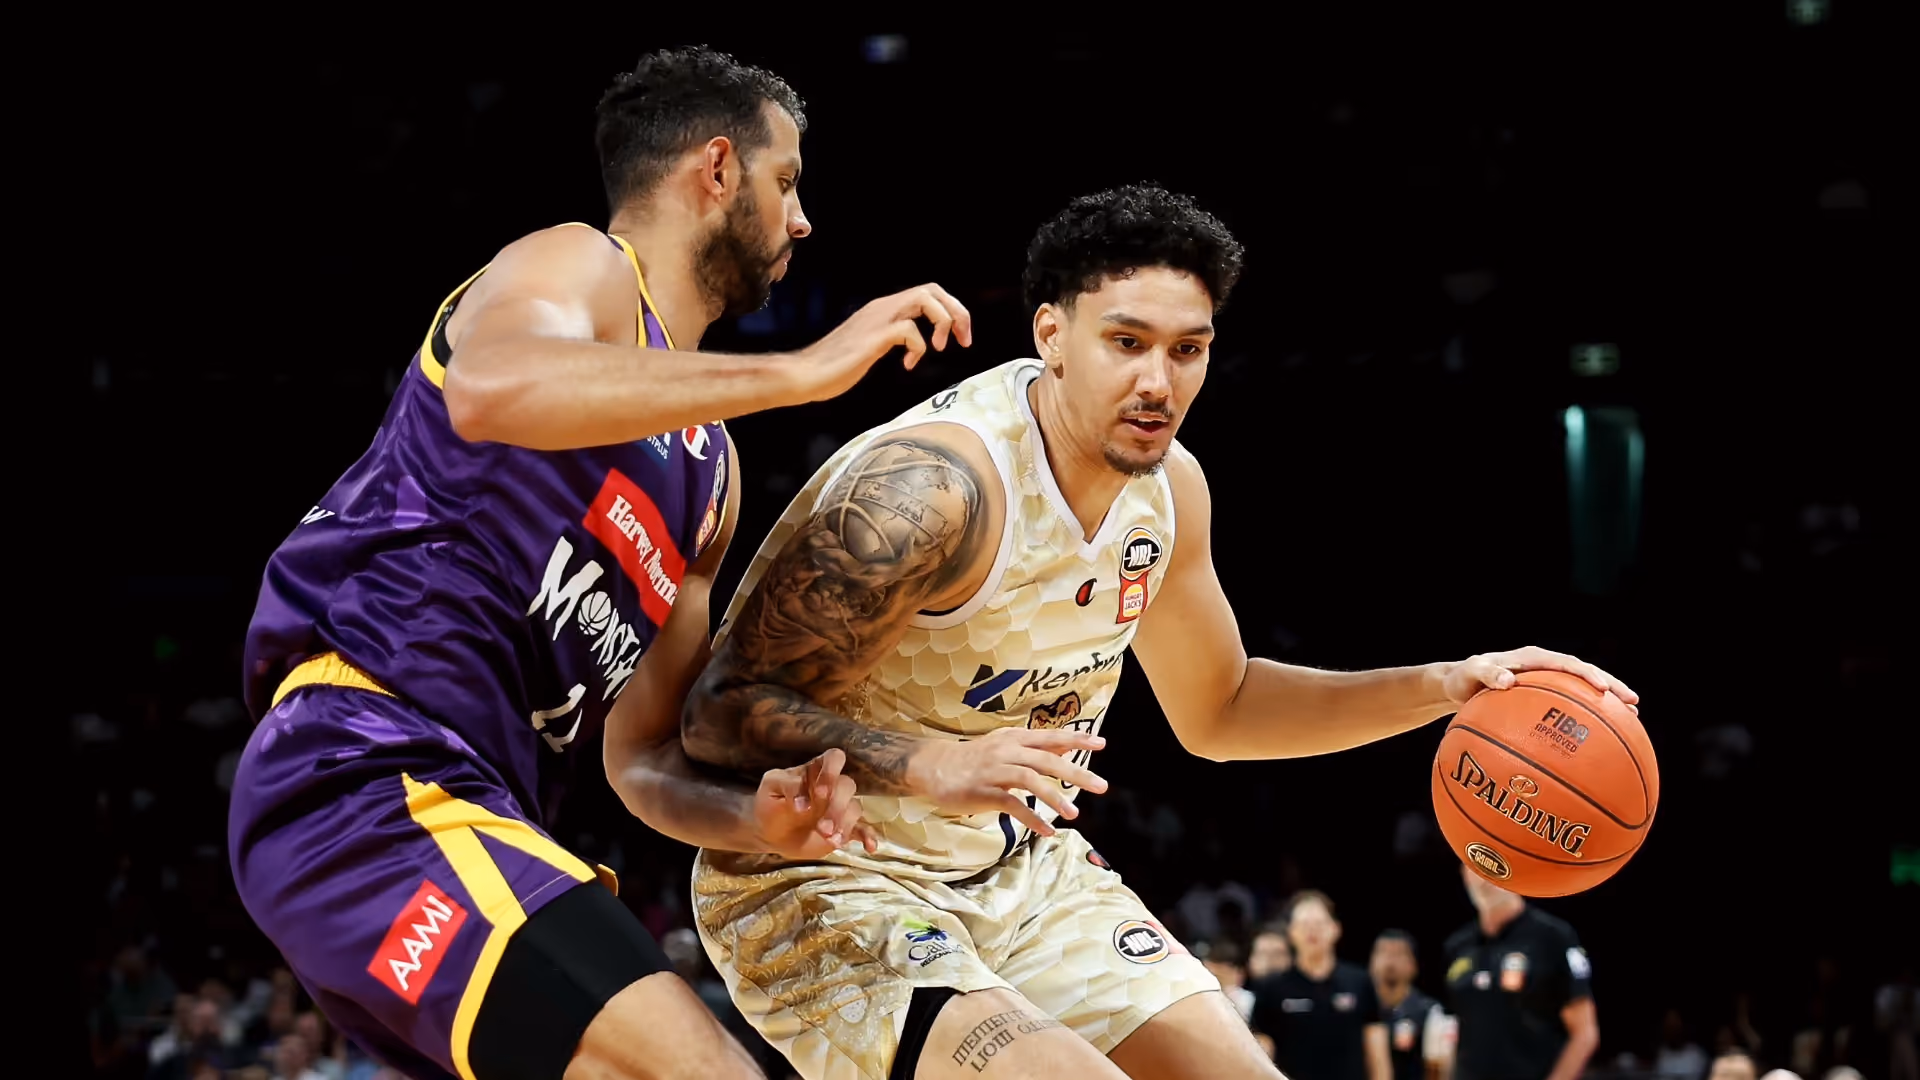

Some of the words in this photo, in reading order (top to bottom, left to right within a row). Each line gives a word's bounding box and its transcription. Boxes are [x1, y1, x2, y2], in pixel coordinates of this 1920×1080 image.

[1128, 543, 1153, 568] NBL
[1534, 723, 1578, 753] APPROVED
[1541, 706, 1589, 745] FIBA
[1450, 750, 1592, 857] SPALDING
[1474, 850, 1499, 875] NBL
[388, 894, 454, 991] AAMI
[1123, 930, 1161, 955] NBL
